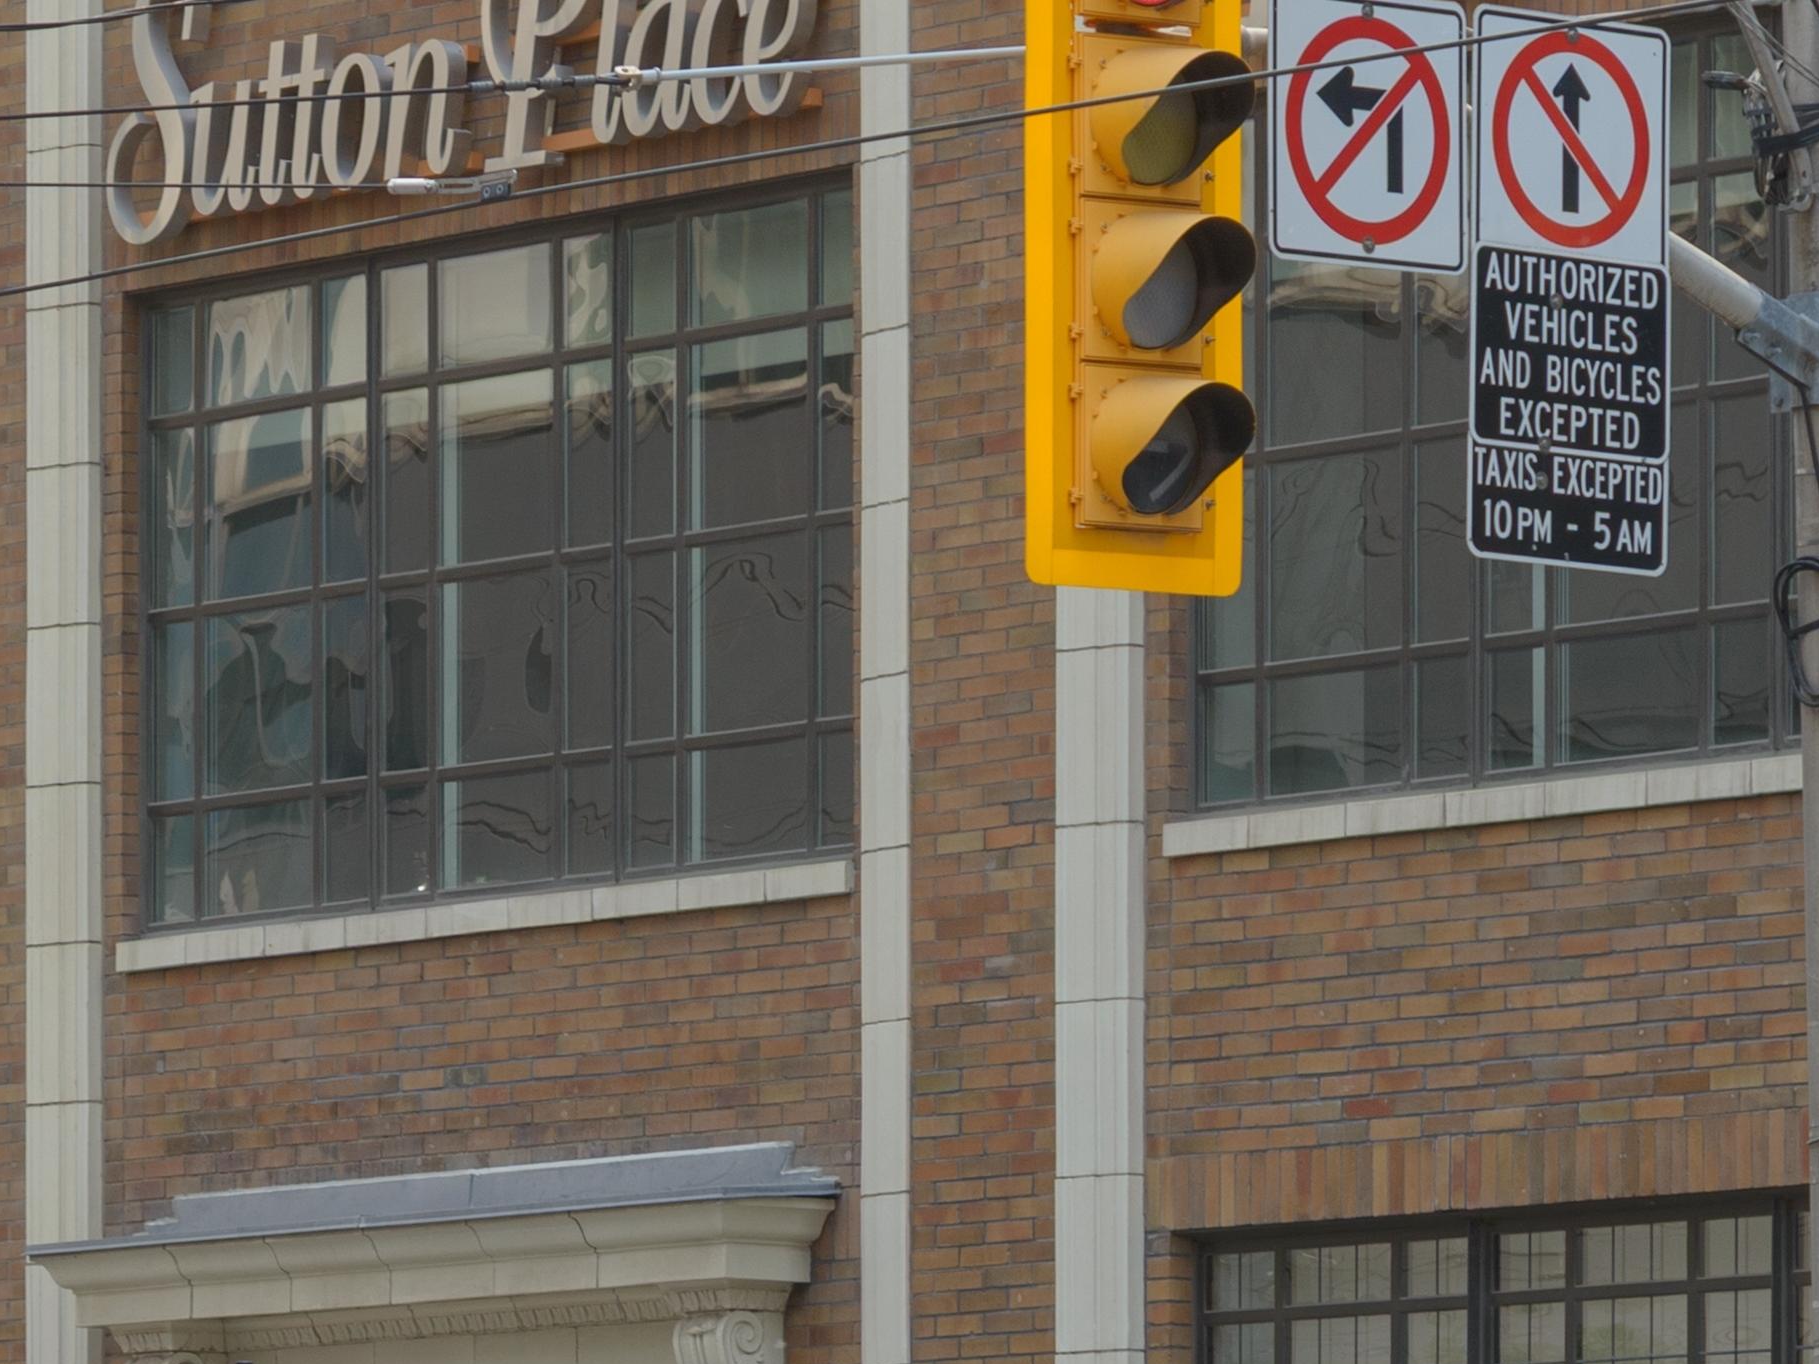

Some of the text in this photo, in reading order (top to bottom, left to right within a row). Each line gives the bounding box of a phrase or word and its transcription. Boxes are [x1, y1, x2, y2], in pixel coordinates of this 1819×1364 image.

[106, 0, 470, 245] Sutton
[1484, 251, 1659, 310] AUTHORIZED
[1504, 300, 1639, 356] VEHICLES
[1480, 346, 1661, 405] AND BICYCLES
[1499, 396, 1640, 450] EXCEPTED
[1474, 446, 1663, 506] TAXIS EXCEPTED
